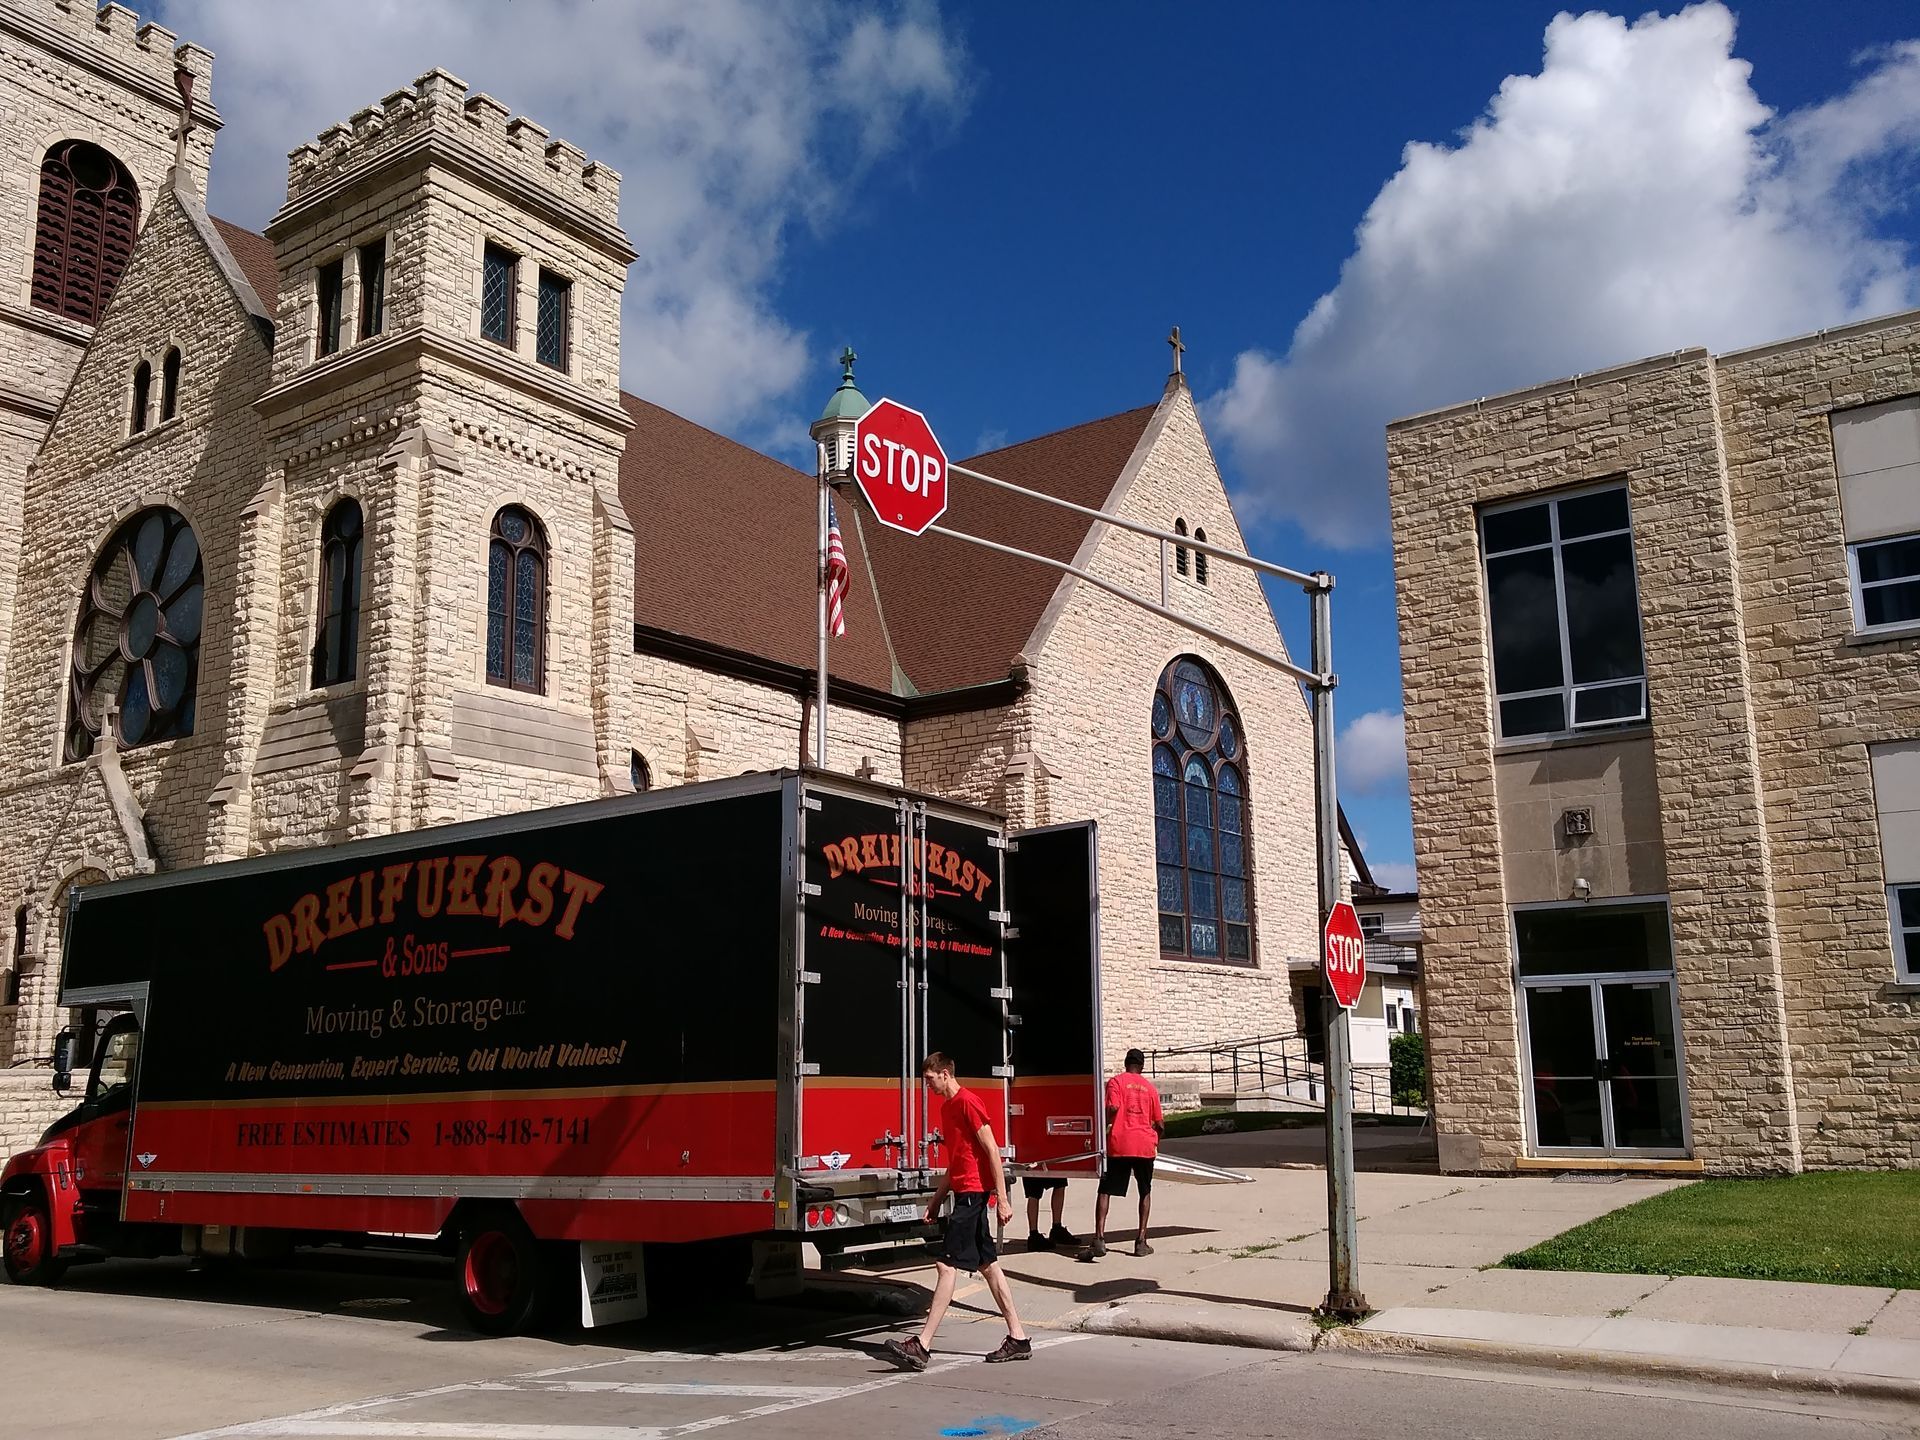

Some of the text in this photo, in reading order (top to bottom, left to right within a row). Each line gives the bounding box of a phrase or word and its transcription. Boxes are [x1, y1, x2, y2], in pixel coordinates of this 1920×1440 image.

[862, 433, 941, 498] STOP
[263, 855, 604, 972] DREIFUERST
[854, 903, 954, 935] Moving Sorage
[382, 934, 449, 977] & Sons
[820, 926, 828, 937] A
[828, 926, 845, 939] New
[952, 941, 971, 954] World
[971, 943, 993, 956] Values!
[1328, 933, 1362, 975] STOP
[304, 996, 526, 1039] Moving & Storage LLC
[224, 1040, 627, 1082] A New Generation, Expert Service, Old World Values!
[237, 1117, 591, 1147] FREE ESTIMATES 1-888-418-7141
